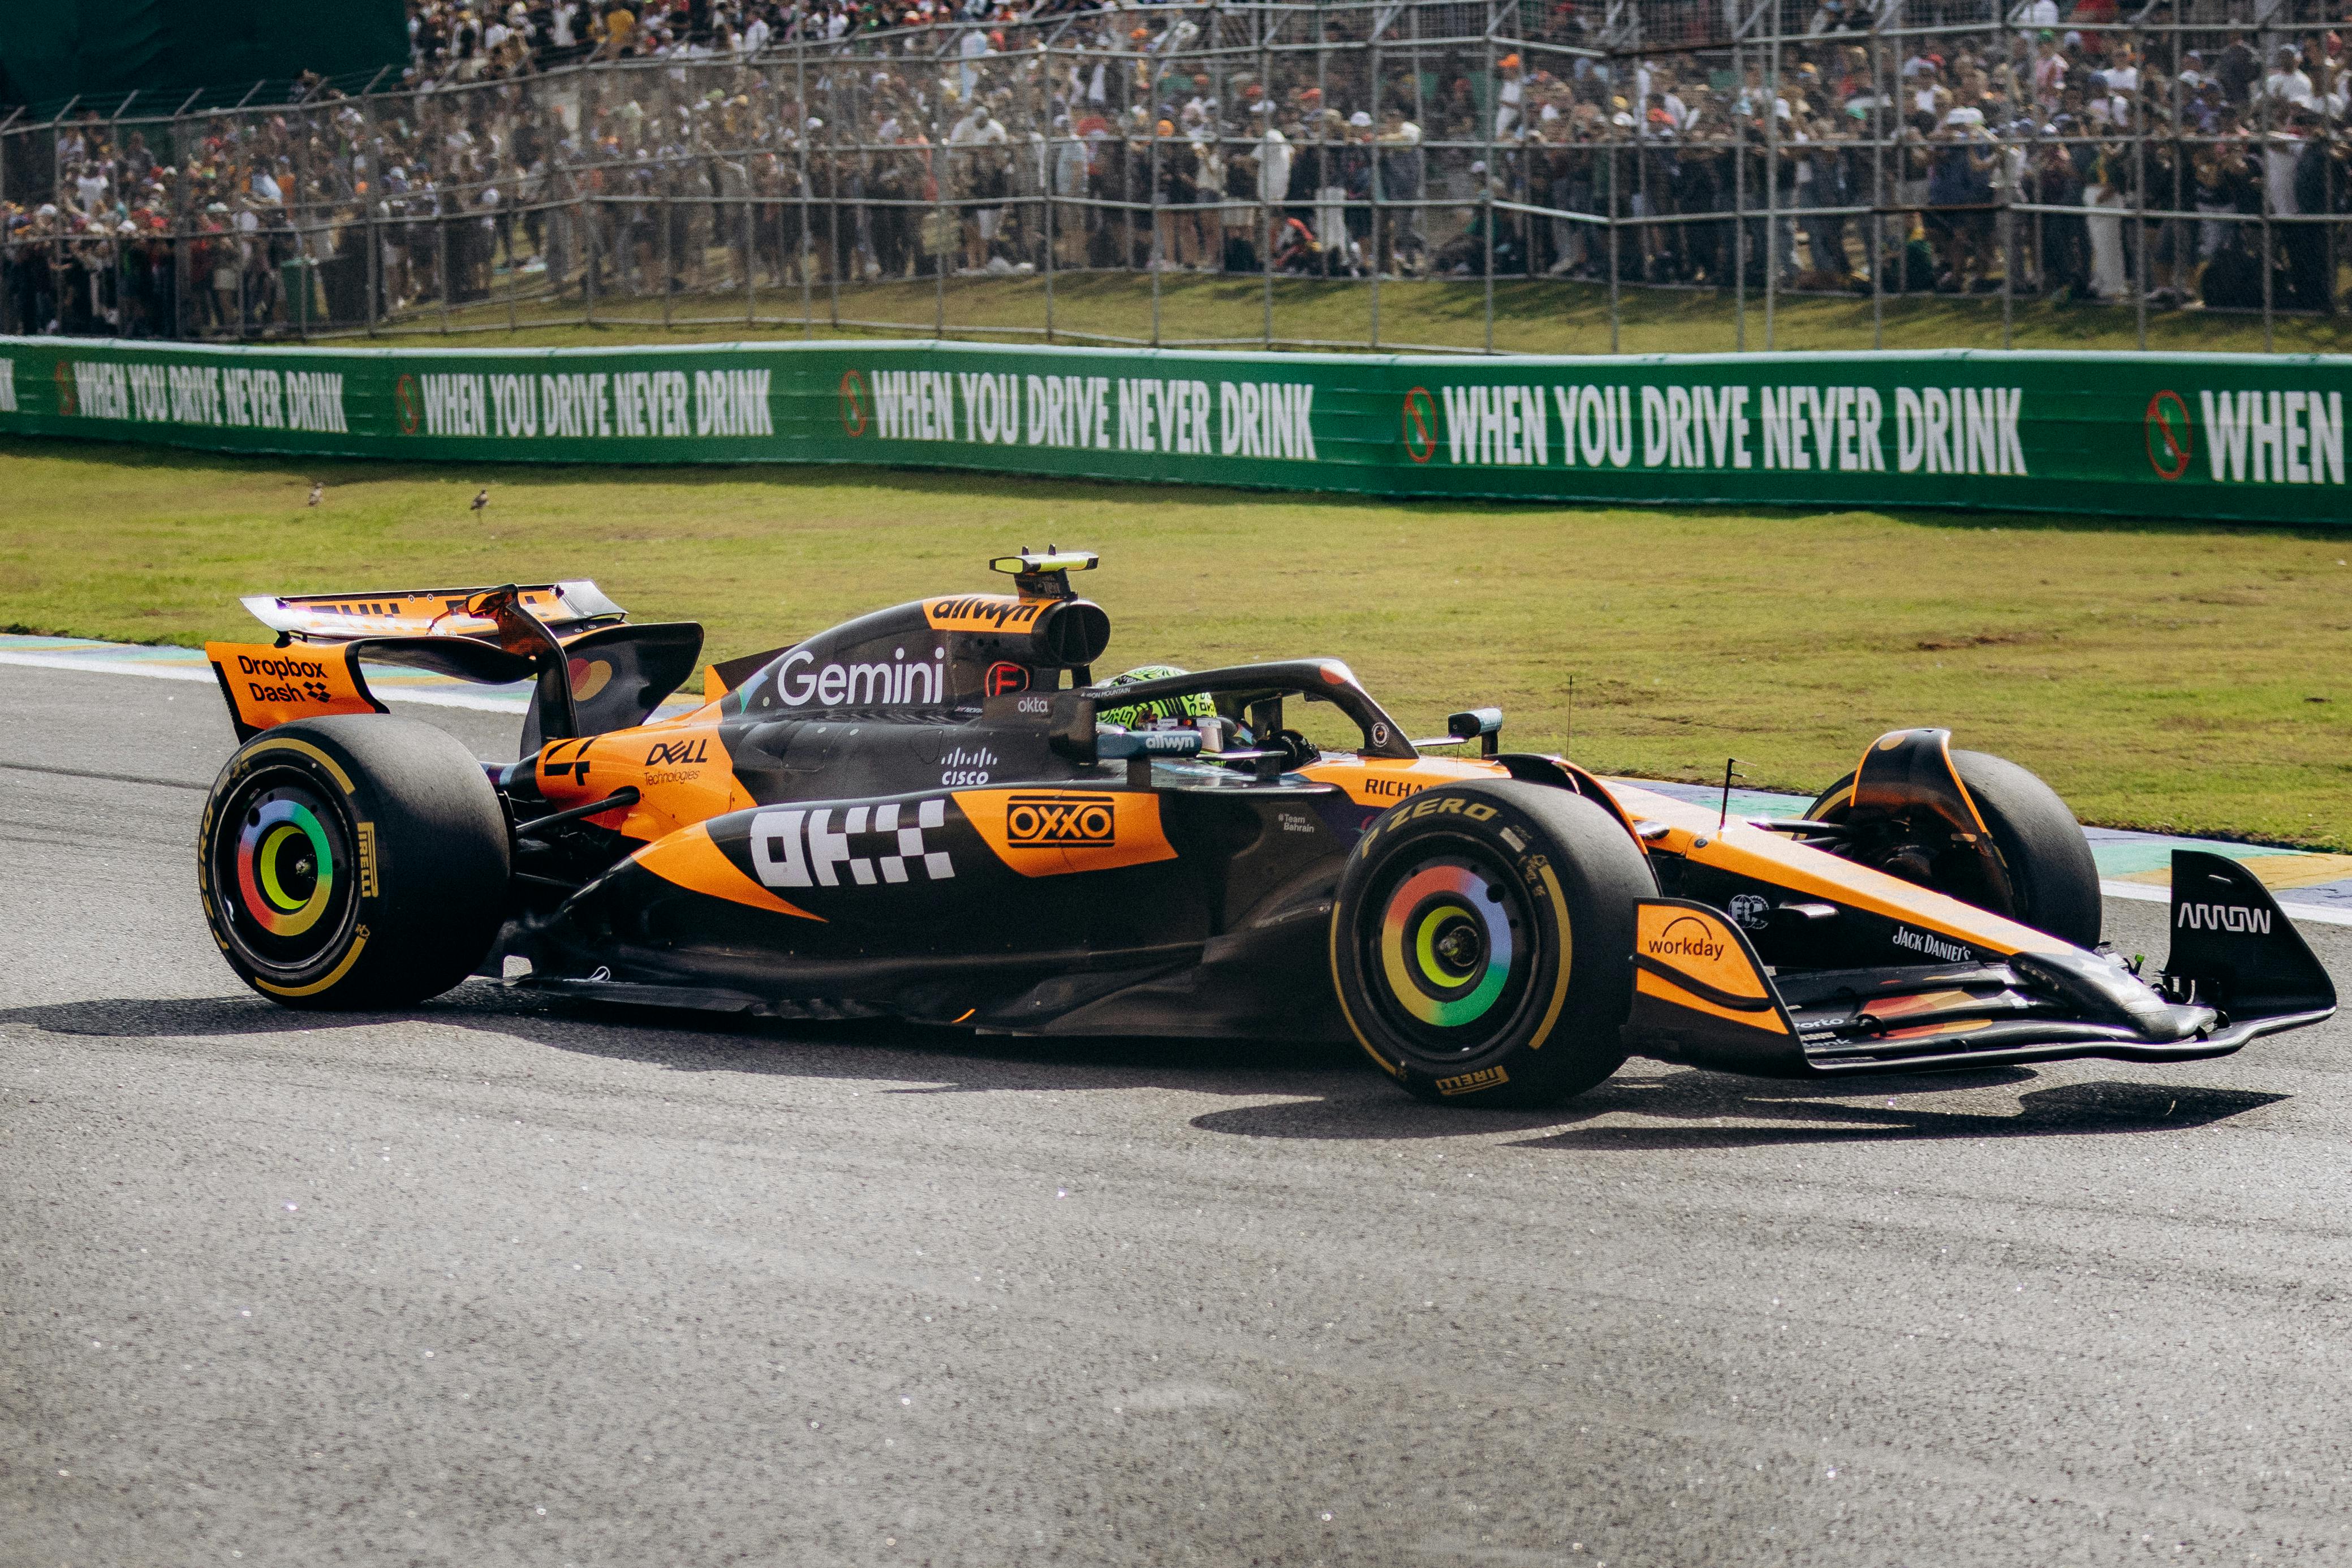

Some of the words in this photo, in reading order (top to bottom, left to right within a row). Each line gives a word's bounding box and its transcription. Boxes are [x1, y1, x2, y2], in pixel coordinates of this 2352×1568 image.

[74, 361, 129, 420] WHEN
[127, 363, 168, 422] YOU
[169, 365, 223, 427] DRIVE
[223, 367, 284, 429] NEVER
[286, 371, 348, 433] DRINK
[421, 373, 486, 436] WHEN
[490, 374, 537, 437] YOU
[541, 373, 610, 437] DRIVE
[614, 371, 690, 436] NEVER
[695, 369, 774, 436] DRINK
[871, 370, 955, 440] WHEN
[958, 372, 1019, 445] YOU
[1026, 374, 1110, 449] DRIVE
[1118, 377, 1213, 454] NEVER
[1220, 382, 1317, 460] DRINK
[1442, 386, 1548, 466] WHEN
[1554, 385, 1632, 468] YOU
[1642, 385, 1751, 469] DRIVE
[1760, 386, 1885, 472] NEVER
[1895, 387, 2028, 476] DRINK
[2200, 390, 2345, 484] WHEN
[933, 597, 1039, 628] allwyn
[238, 655, 328, 680] Dropbox
[777, 647, 945, 707] Gemini
[248, 683, 306, 702] Dash
[1018, 696, 1048, 712] okta
[645, 739, 708, 766] DELL
[1145, 735, 1195, 751] allwyn
[644, 769, 700, 786] Technologies
[1009, 805, 1114, 840] OXXO
[1278, 813, 1306, 824] #Team
[1283, 822, 1315, 833] Bahrain
[1362, 827, 1380, 860] P
[1387, 797, 1499, 832] ZERO
[750, 799, 955, 887] OKX
[357, 822, 378, 898] PIRELLI
[1648, 937, 1724, 961] workday
[1893, 926, 1924, 951] JACK
[1436, 1065, 1509, 1096] PIRELLI
